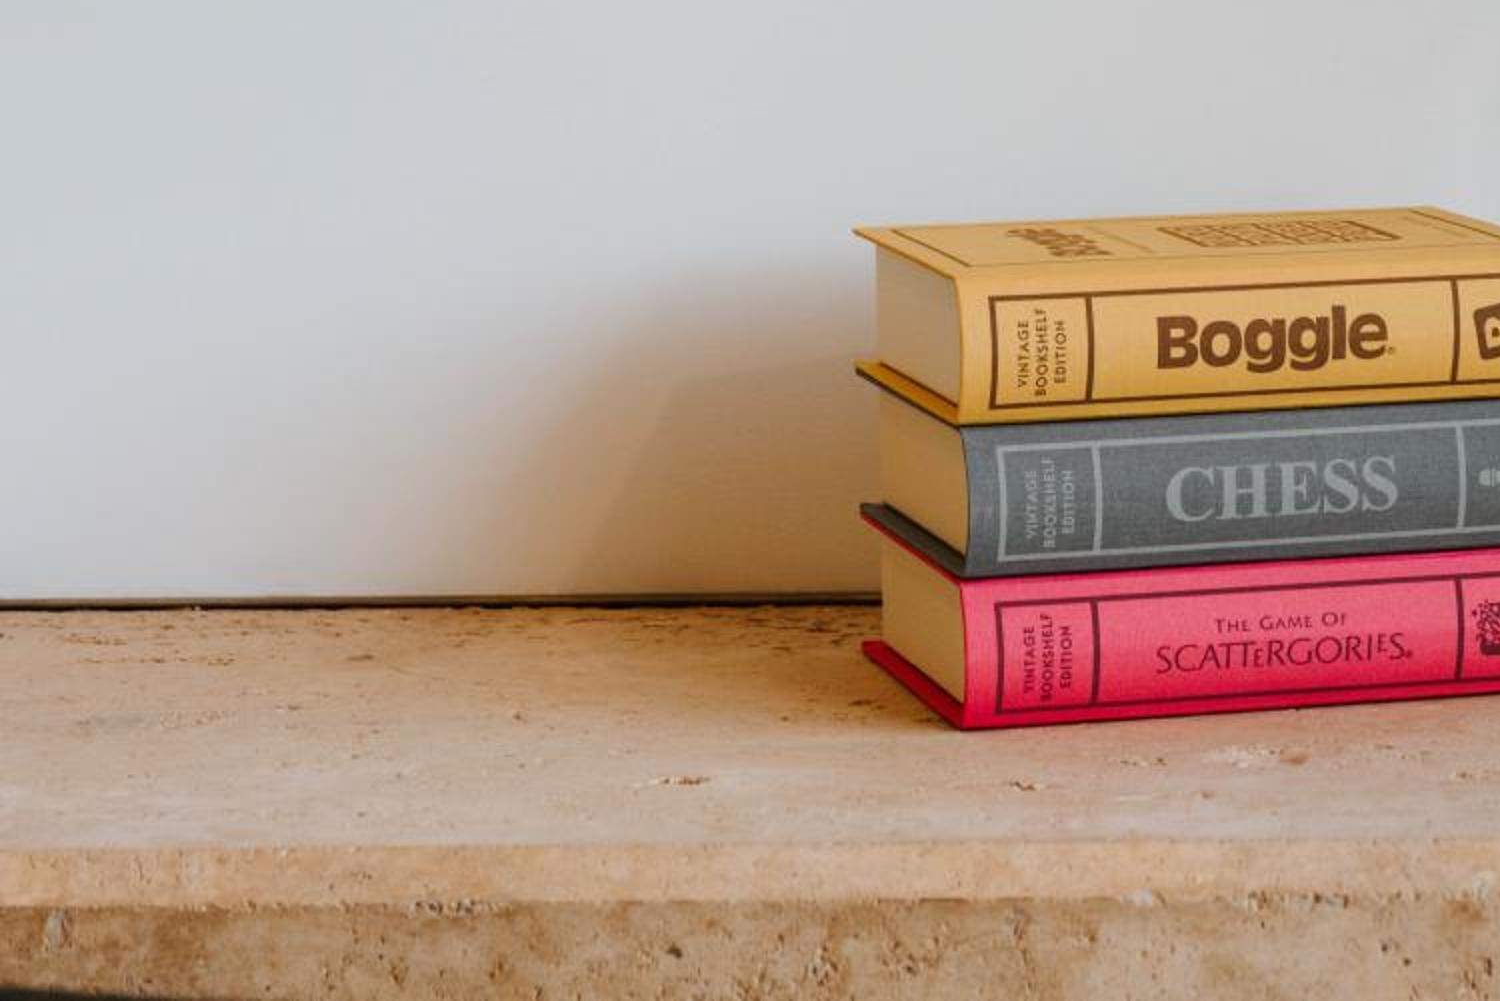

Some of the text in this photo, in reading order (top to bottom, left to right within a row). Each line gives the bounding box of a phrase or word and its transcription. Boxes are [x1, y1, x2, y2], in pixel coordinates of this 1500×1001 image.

[1017, 319, 1030, 388] VINTAGE
[1034, 308, 1048, 397] BOOKSHELF
[1054, 320, 1066, 384] EDITION
[1155, 304, 1388, 373] Boggle
[1024, 470, 1039, 539] VINTAGE
[1041, 455, 1057, 548] BOOKSHELF
[1061, 470, 1074, 535] EDITION
[1165, 454, 1399, 522] CHESS
[1040, 613, 1054, 702] BOOKSHELF
[1060, 626, 1072, 689] EDITION
[1155, 632, 1408, 675] SCATTERGORIES
[1215, 617, 1250, 634] THE
[1258, 614, 1314, 632] GAME
[1023, 626, 1035, 694] VINTAGE
